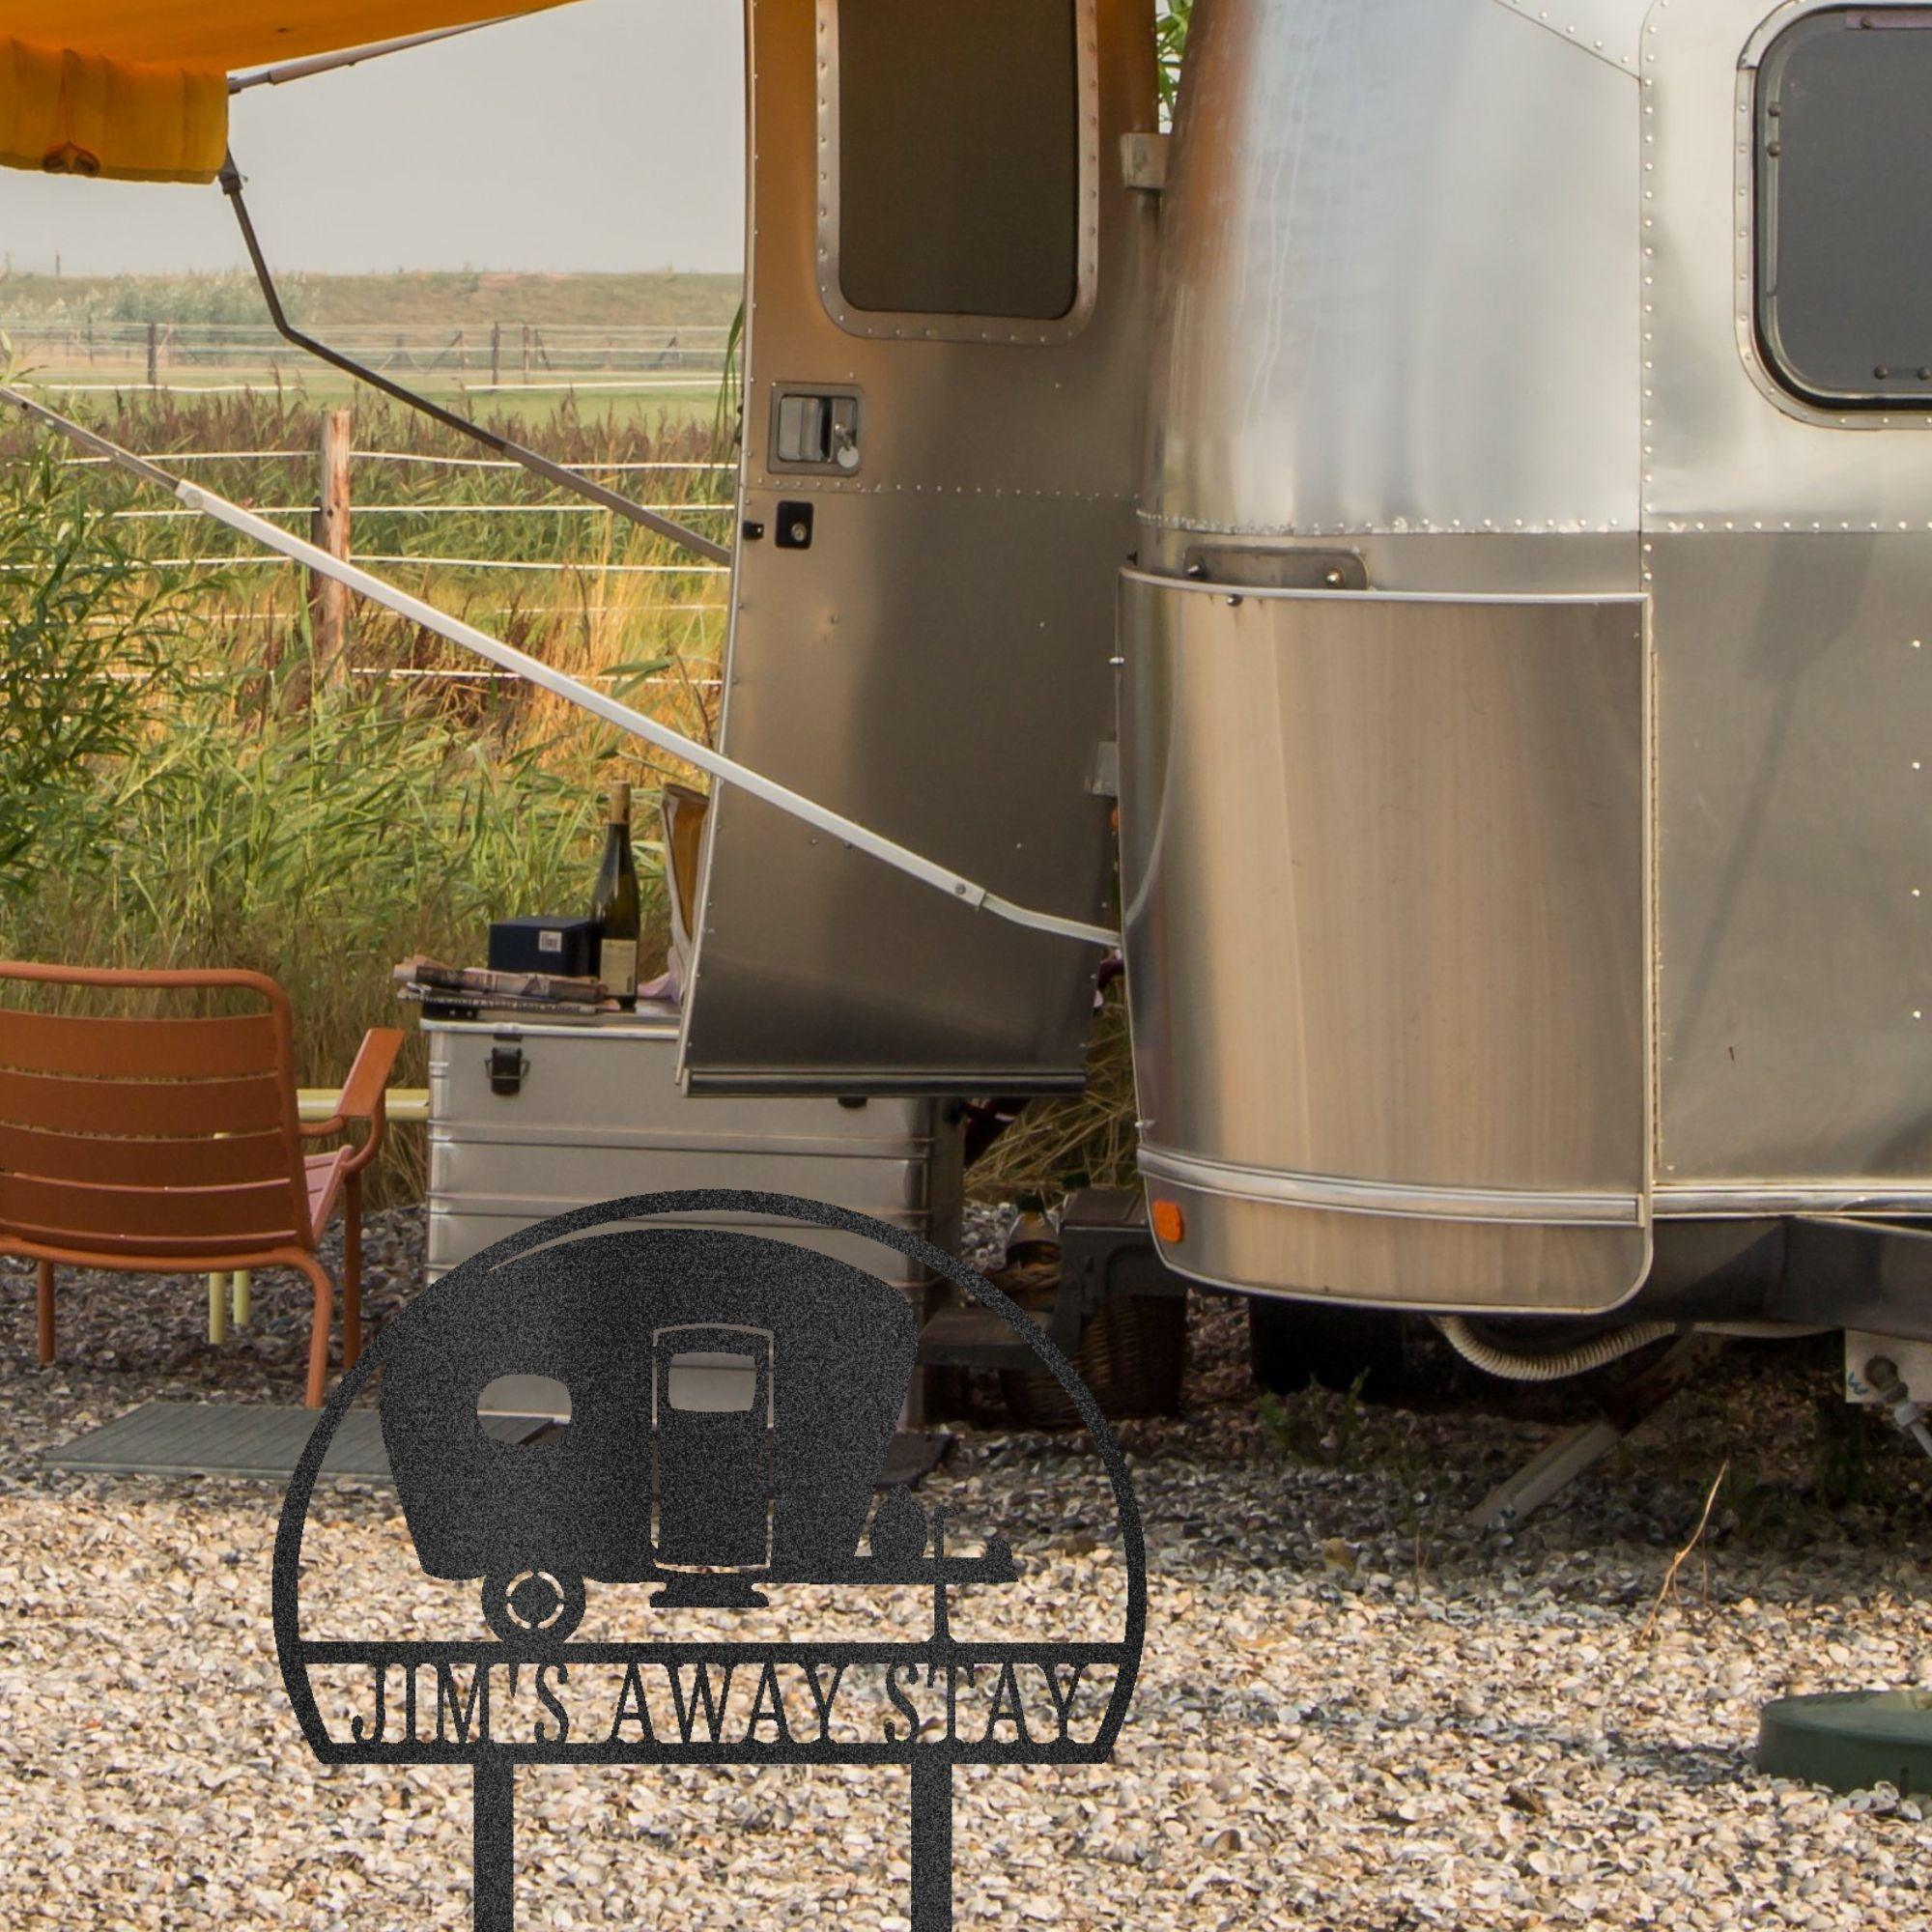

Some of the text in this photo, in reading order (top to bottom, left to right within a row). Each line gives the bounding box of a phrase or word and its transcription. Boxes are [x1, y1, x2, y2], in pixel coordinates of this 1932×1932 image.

[352, 1661, 1088, 1745] JIM'S AWAY STAY
